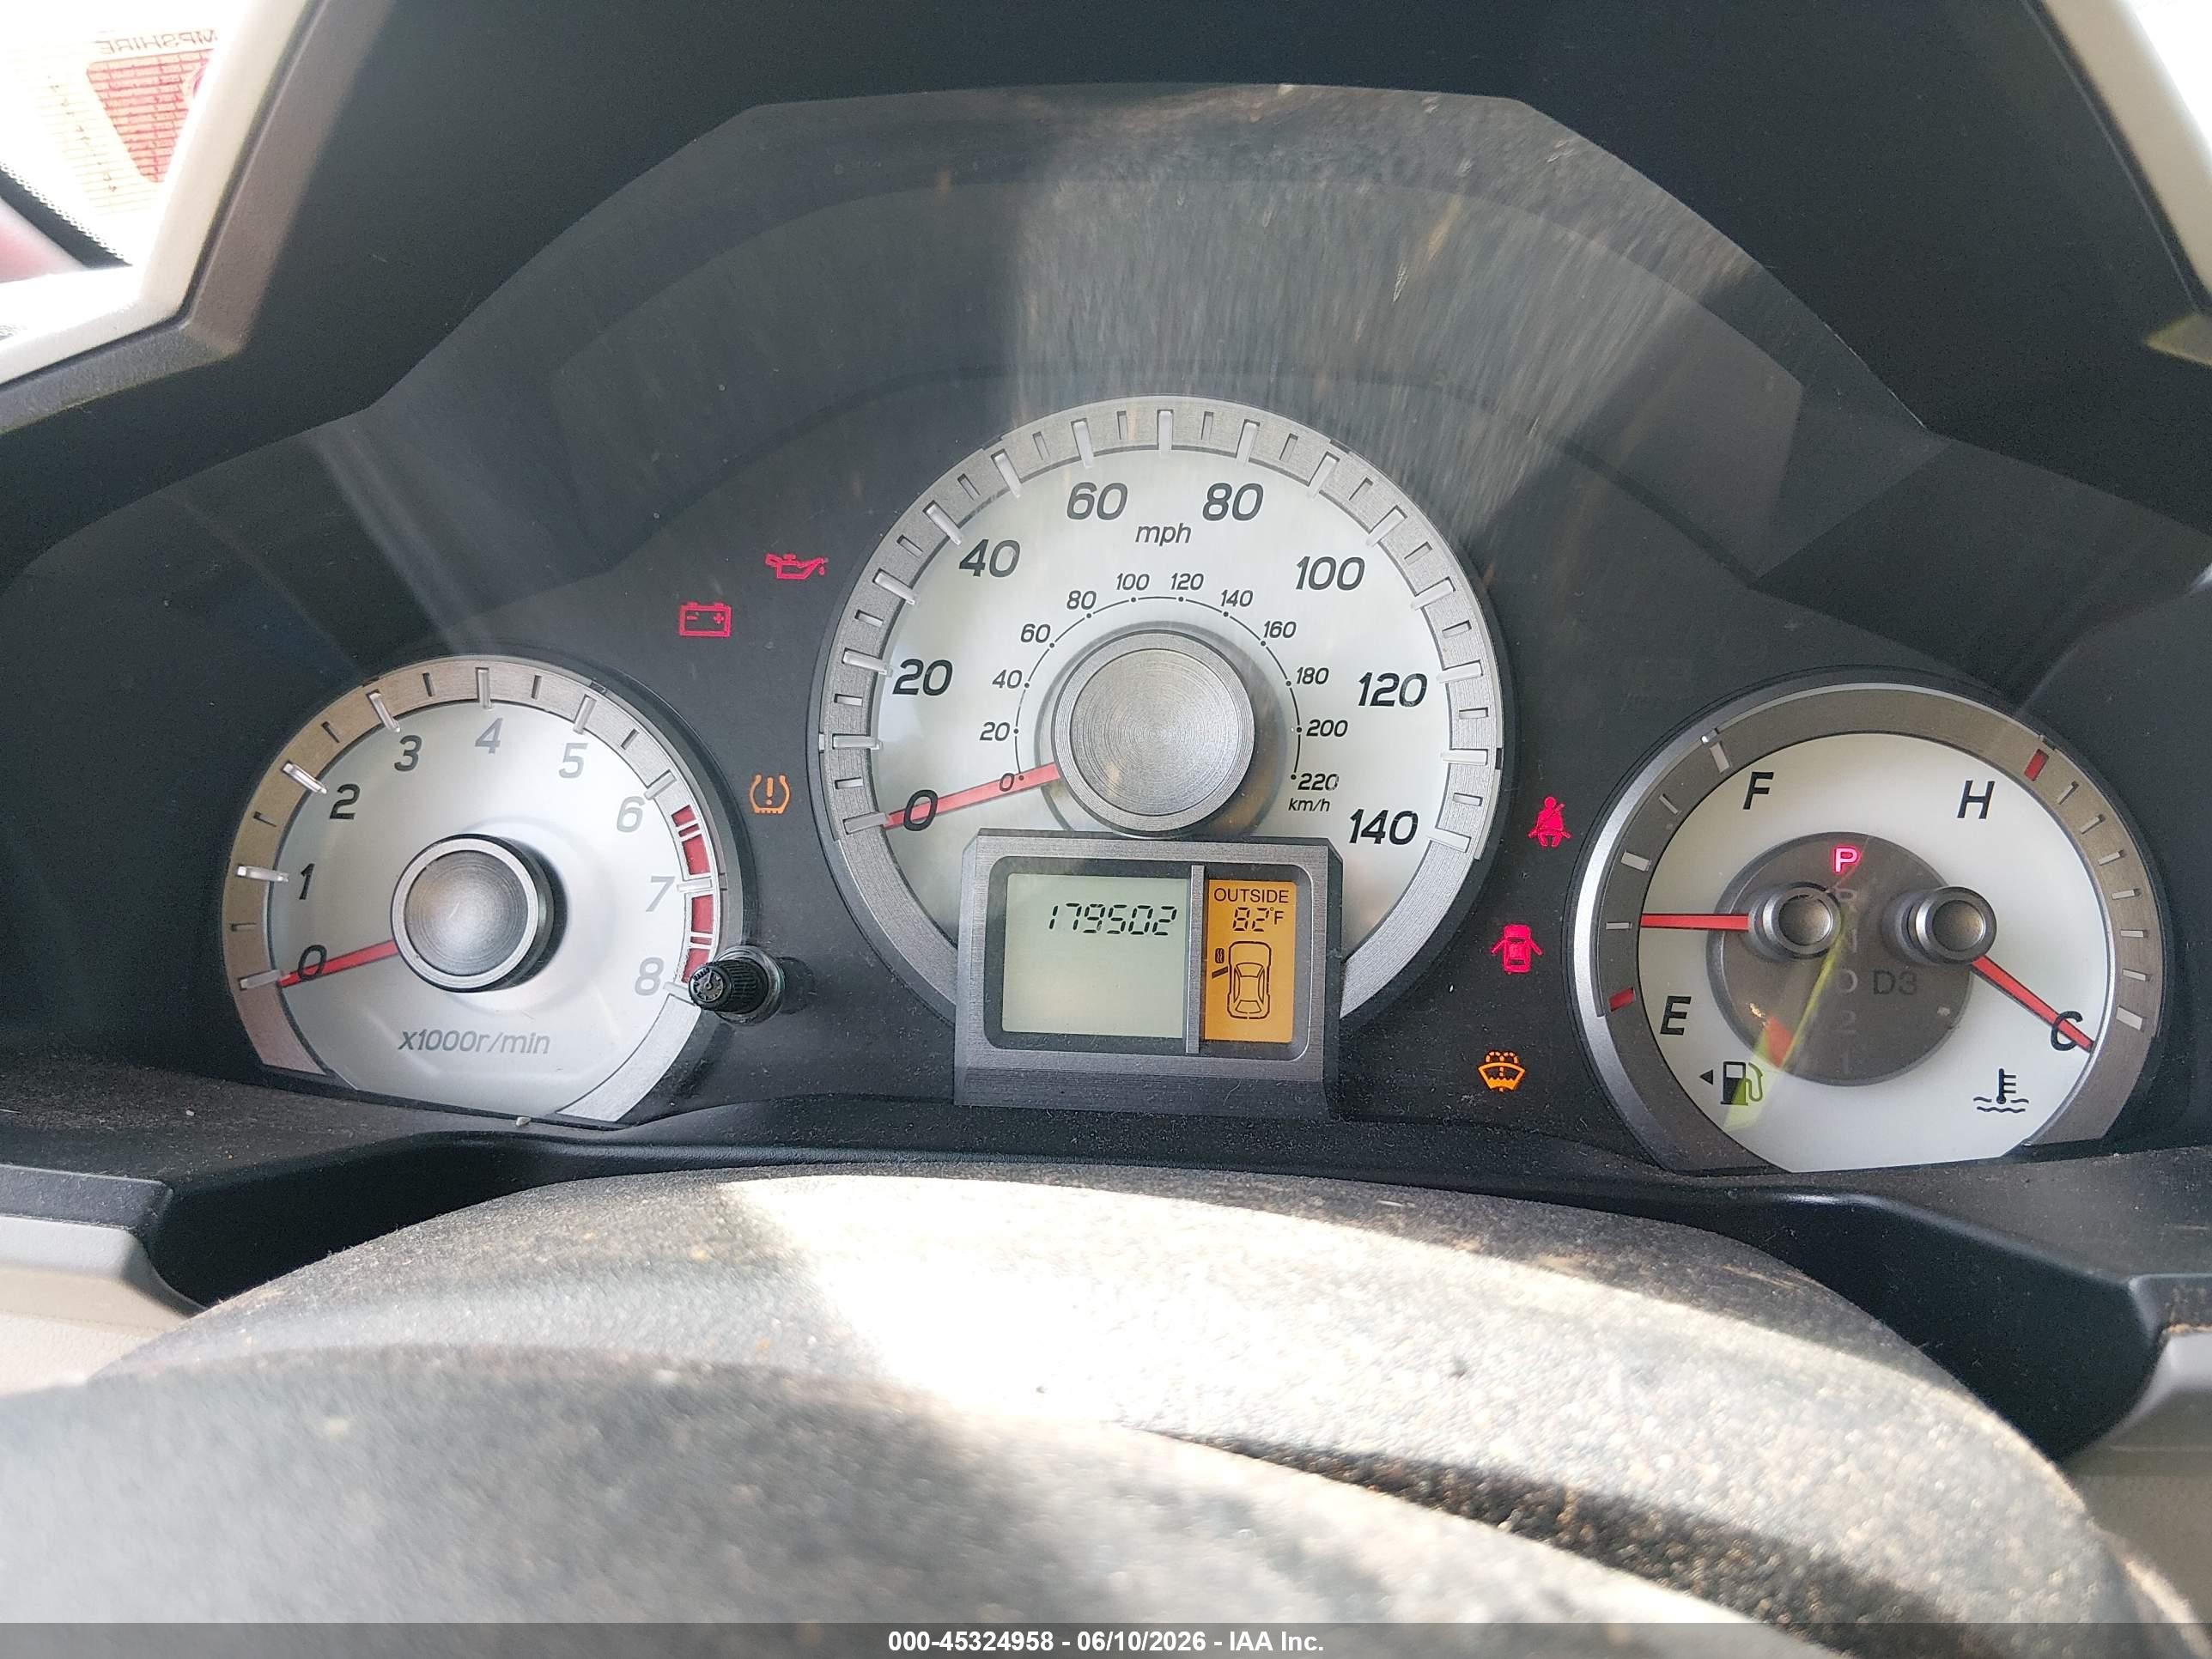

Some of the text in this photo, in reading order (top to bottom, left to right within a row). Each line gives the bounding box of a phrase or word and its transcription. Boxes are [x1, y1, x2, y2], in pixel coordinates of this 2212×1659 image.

[1066, 482, 1127, 520] 60
[1202, 483, 1263, 521] 80
[1135, 522, 1191, 546] mph
[959, 539, 1020, 577] 40
[1296, 556, 1364, 590] 100
[1116, 573, 1149, 591] 100
[1170, 573, 1203, 591] 120
[1220, 590, 1253, 607] 140
[1066, 590, 1097, 610] 80
[1020, 623, 1051, 643] 60
[1263, 621, 1296, 639] 160
[892, 659, 952, 696] 20
[993, 670, 1022, 689] 40
[1296, 667, 1329, 685] 180
[1358, 672, 1427, 708] 120
[475, 719, 503, 754] 4
[980, 722, 1010, 742] 20
[1306, 720, 1347, 738] 200
[394, 735, 422, 772] 3
[559, 743, 587, 778] 5
[999, 773, 1015, 792] 0
[1297, 773, 1339, 791] 220
[1743, 771, 1774, 810] F
[330, 784, 360, 819] 2
[617, 796, 644, 832] 6
[902, 789, 938, 831] 0
[1288, 797, 1330, 813] km/h
[1957, 780, 1996, 820] H
[1348, 809, 1418, 845] 140
[1833, 847, 1858, 873] P
[300, 864, 314, 900] 1
[646, 877, 674, 912] 7
[1213, 887, 1290, 904] OUTSIDE
[1048, 903, 1177, 936] 179502
[298, 945, 327, 981] 0
[635, 958, 664, 995] 8
[1873, 969, 1917, 996] D3
[1660, 995, 1692, 1036] E
[2050, 1011, 2084, 1053] C
[398, 1027, 550, 1056] x1000r/min
